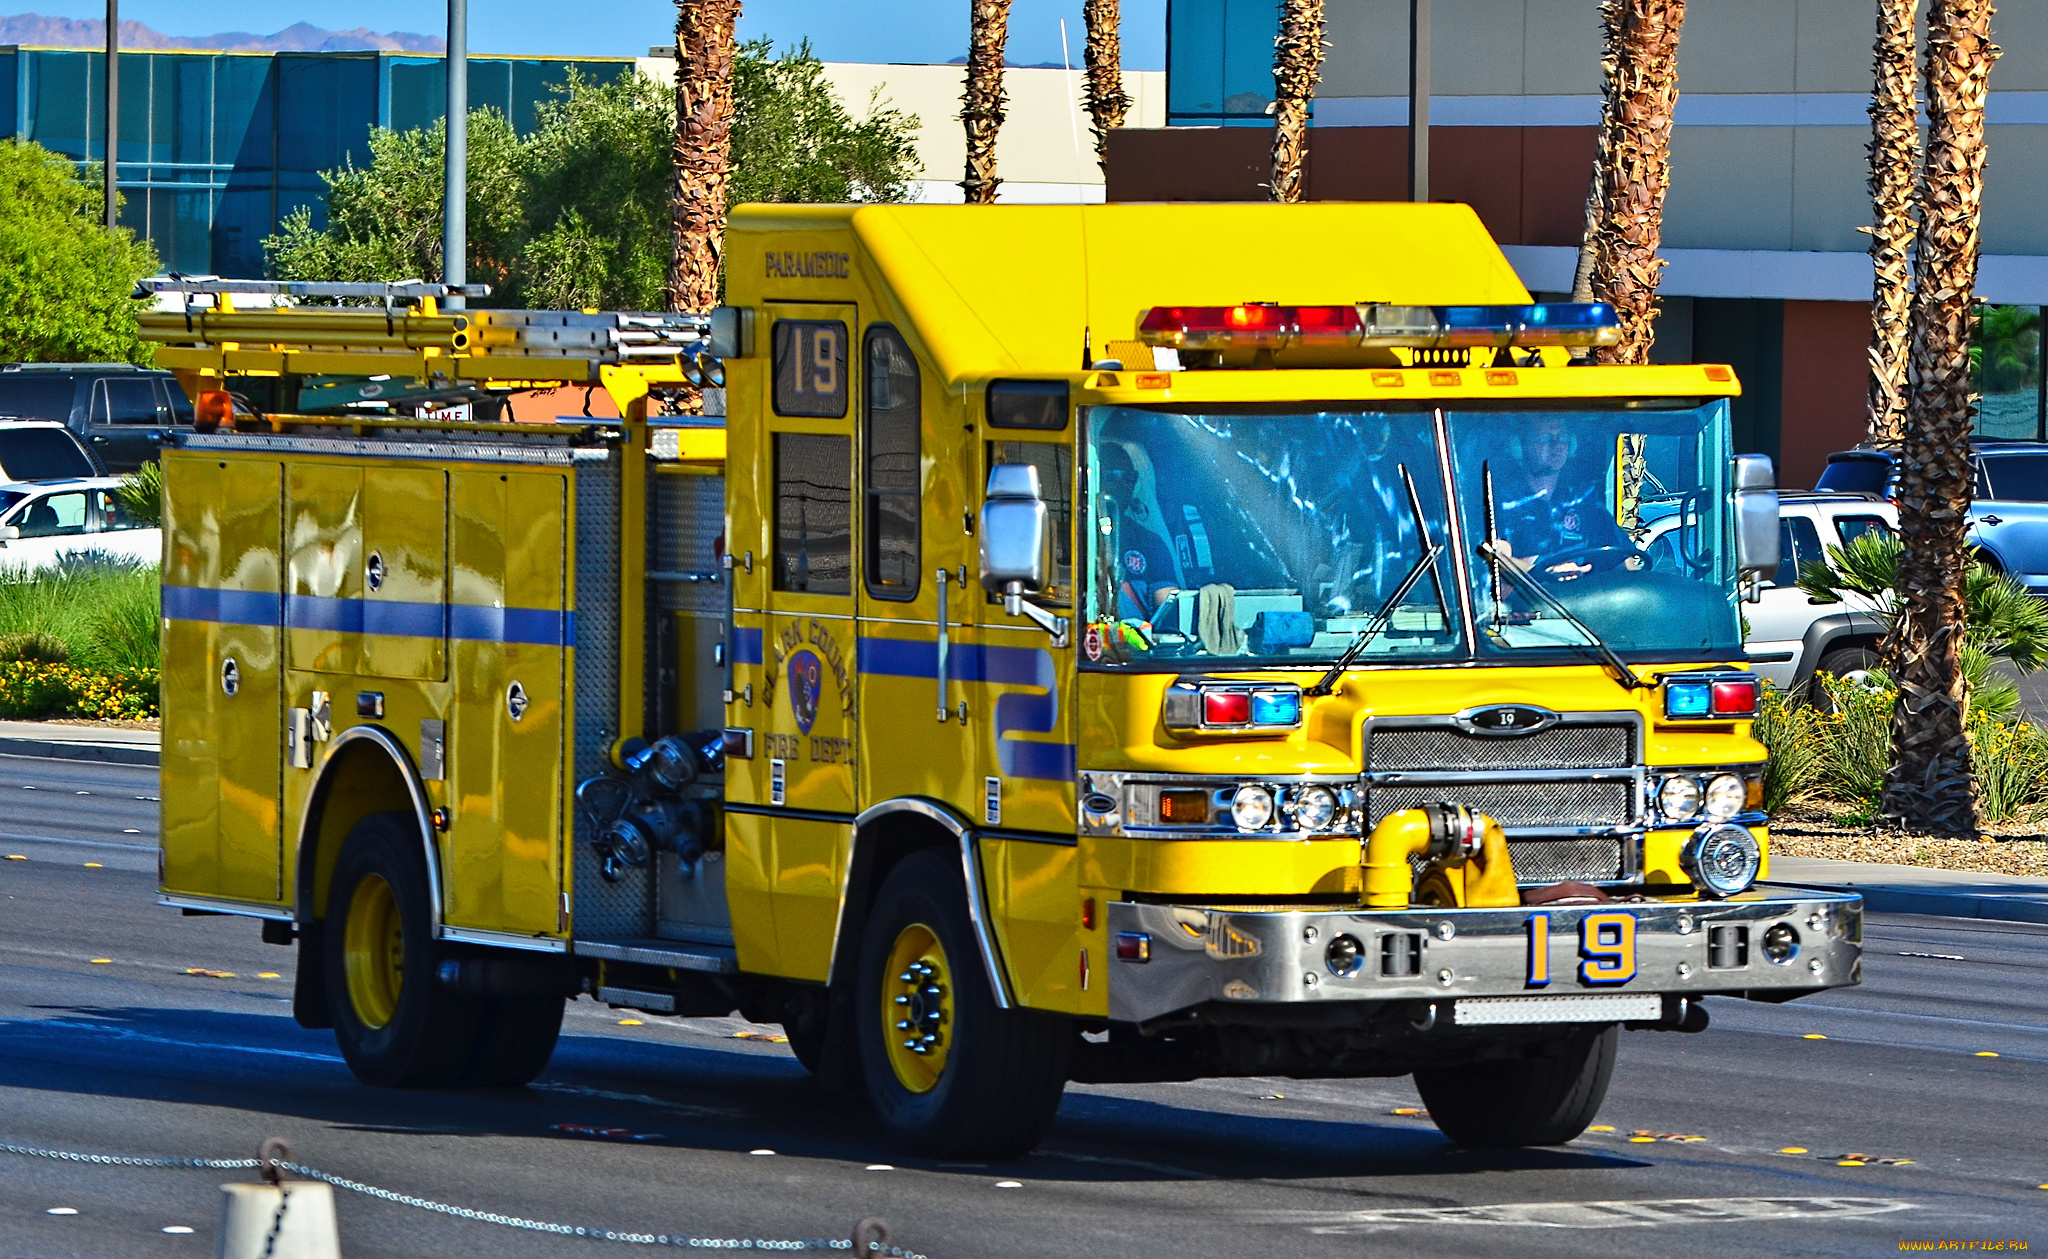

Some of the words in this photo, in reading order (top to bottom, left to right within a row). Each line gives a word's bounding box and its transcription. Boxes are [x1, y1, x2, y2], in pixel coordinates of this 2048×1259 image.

[765, 251, 850, 279] PARAMEDIC
[793, 327, 838, 395] 19
[808, 618, 857, 720] COUNTY
[1499, 713, 1515, 725] 19
[764, 732, 799, 760] FIRE
[1524, 910, 1639, 989] 19
